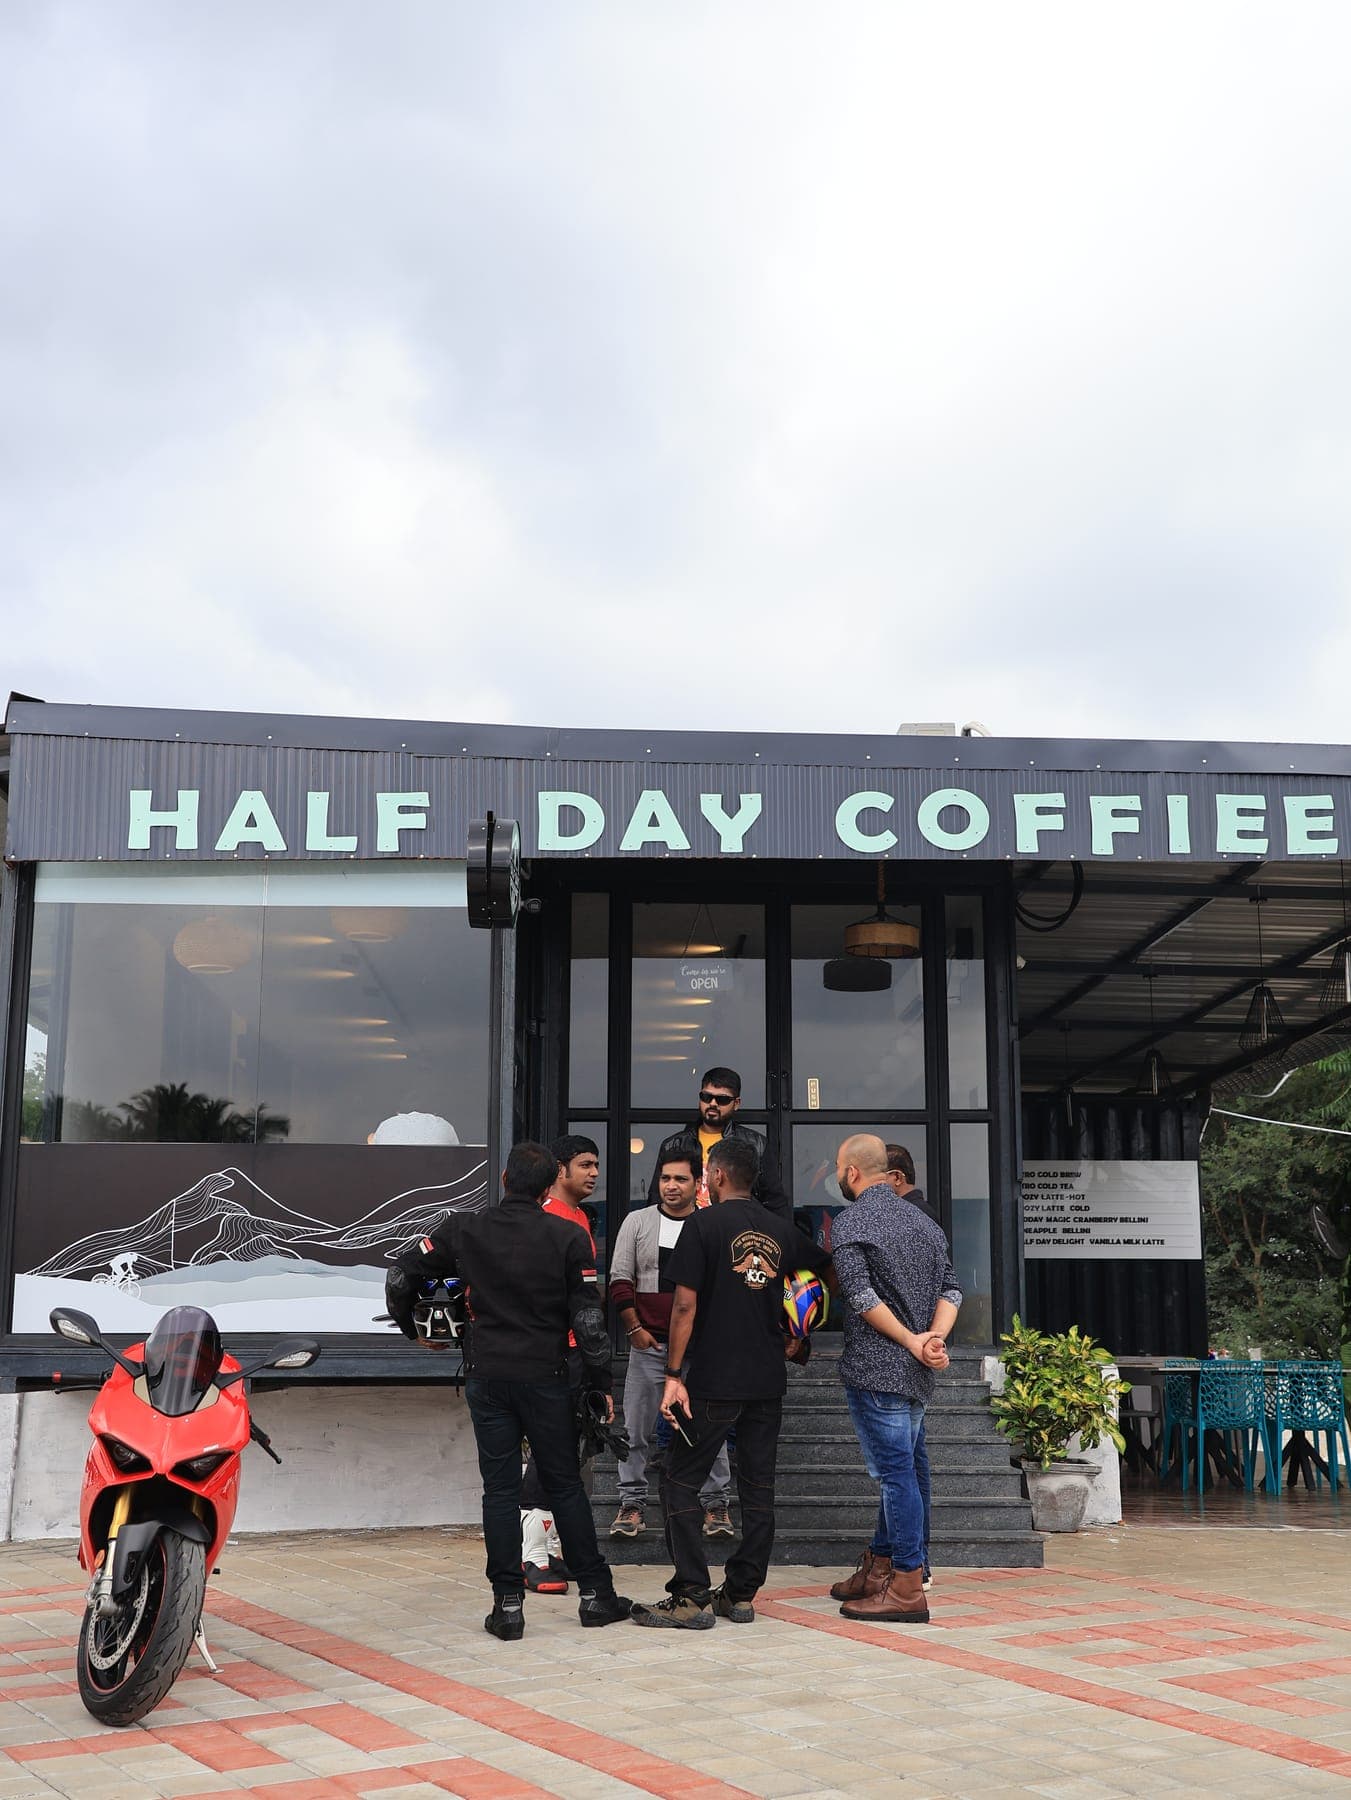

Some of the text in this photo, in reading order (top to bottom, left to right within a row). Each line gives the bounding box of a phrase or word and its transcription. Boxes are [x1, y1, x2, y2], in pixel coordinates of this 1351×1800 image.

[128, 788, 1339, 856] HALF DAY COFFIEE
[691, 977, 718, 989] OPEN
